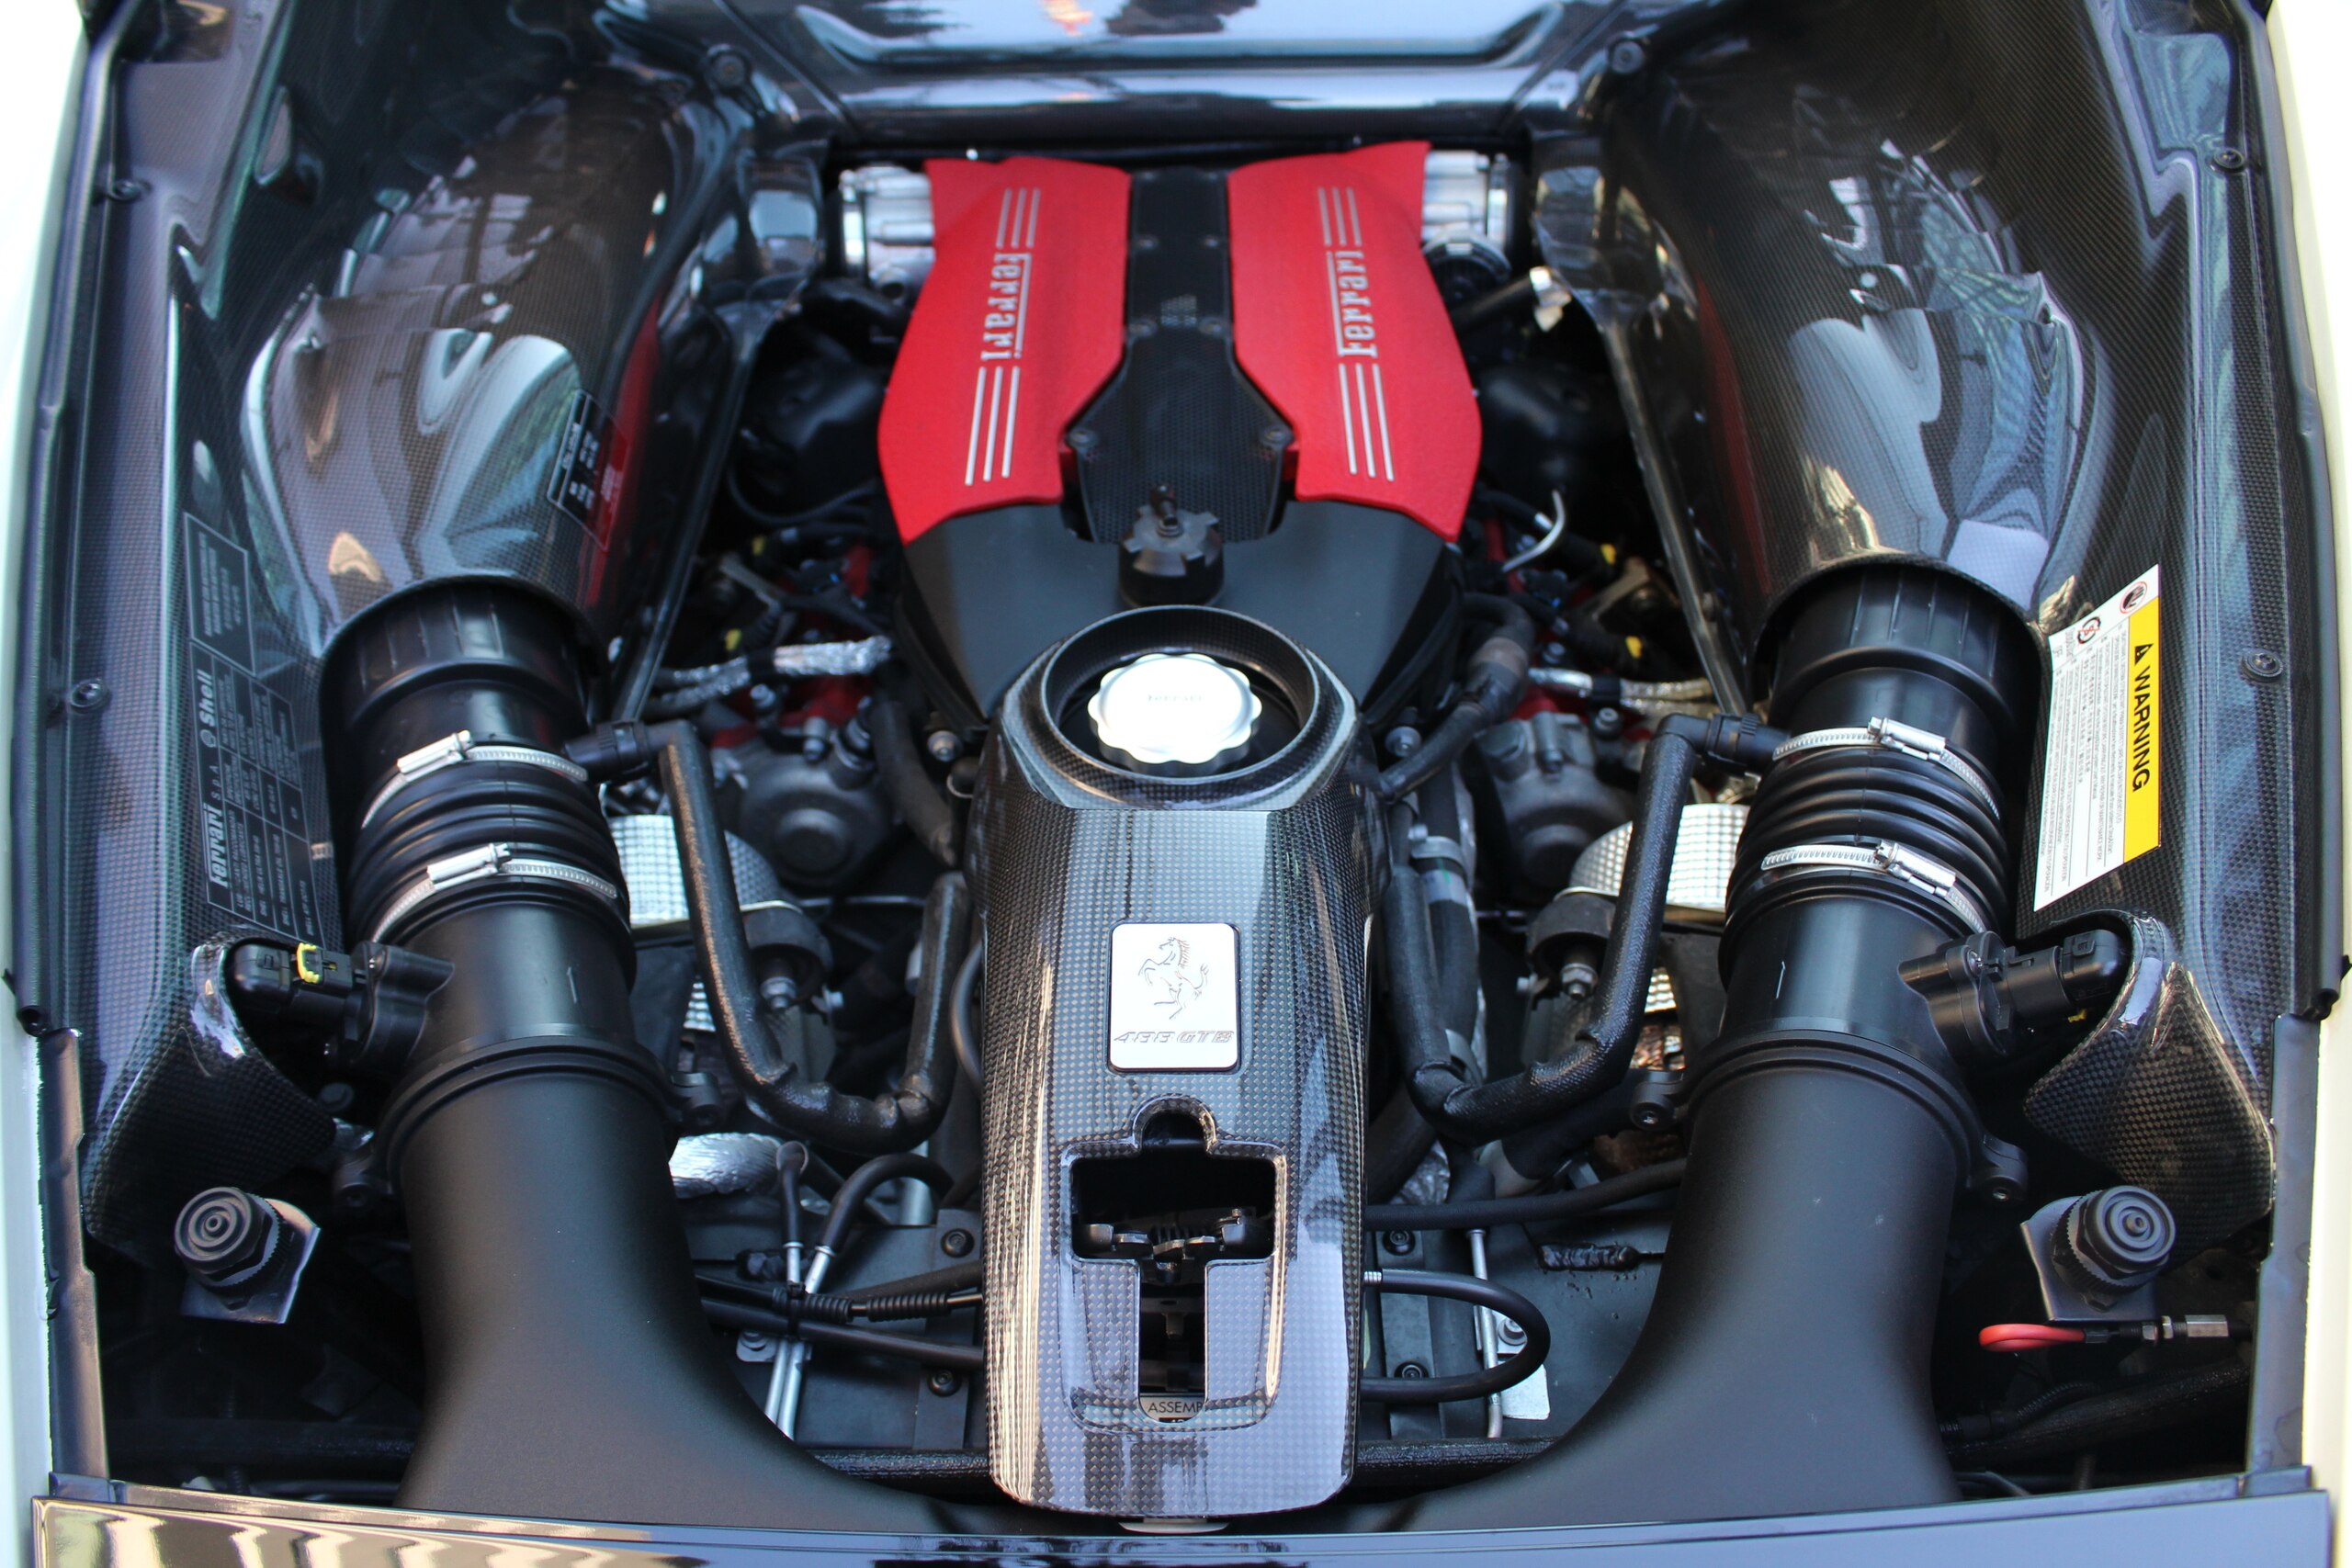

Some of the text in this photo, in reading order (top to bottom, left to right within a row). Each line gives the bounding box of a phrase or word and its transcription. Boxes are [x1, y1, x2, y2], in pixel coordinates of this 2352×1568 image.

[980, 253, 1032, 361] Ferrari
[1326, 251, 1378, 358] Ferrari
[197, 669, 216, 727] Shell
[2132, 665, 2151, 792] WARNING
[203, 803, 229, 887] Ferrari
[1177, 1030, 1235, 1043] GTB
